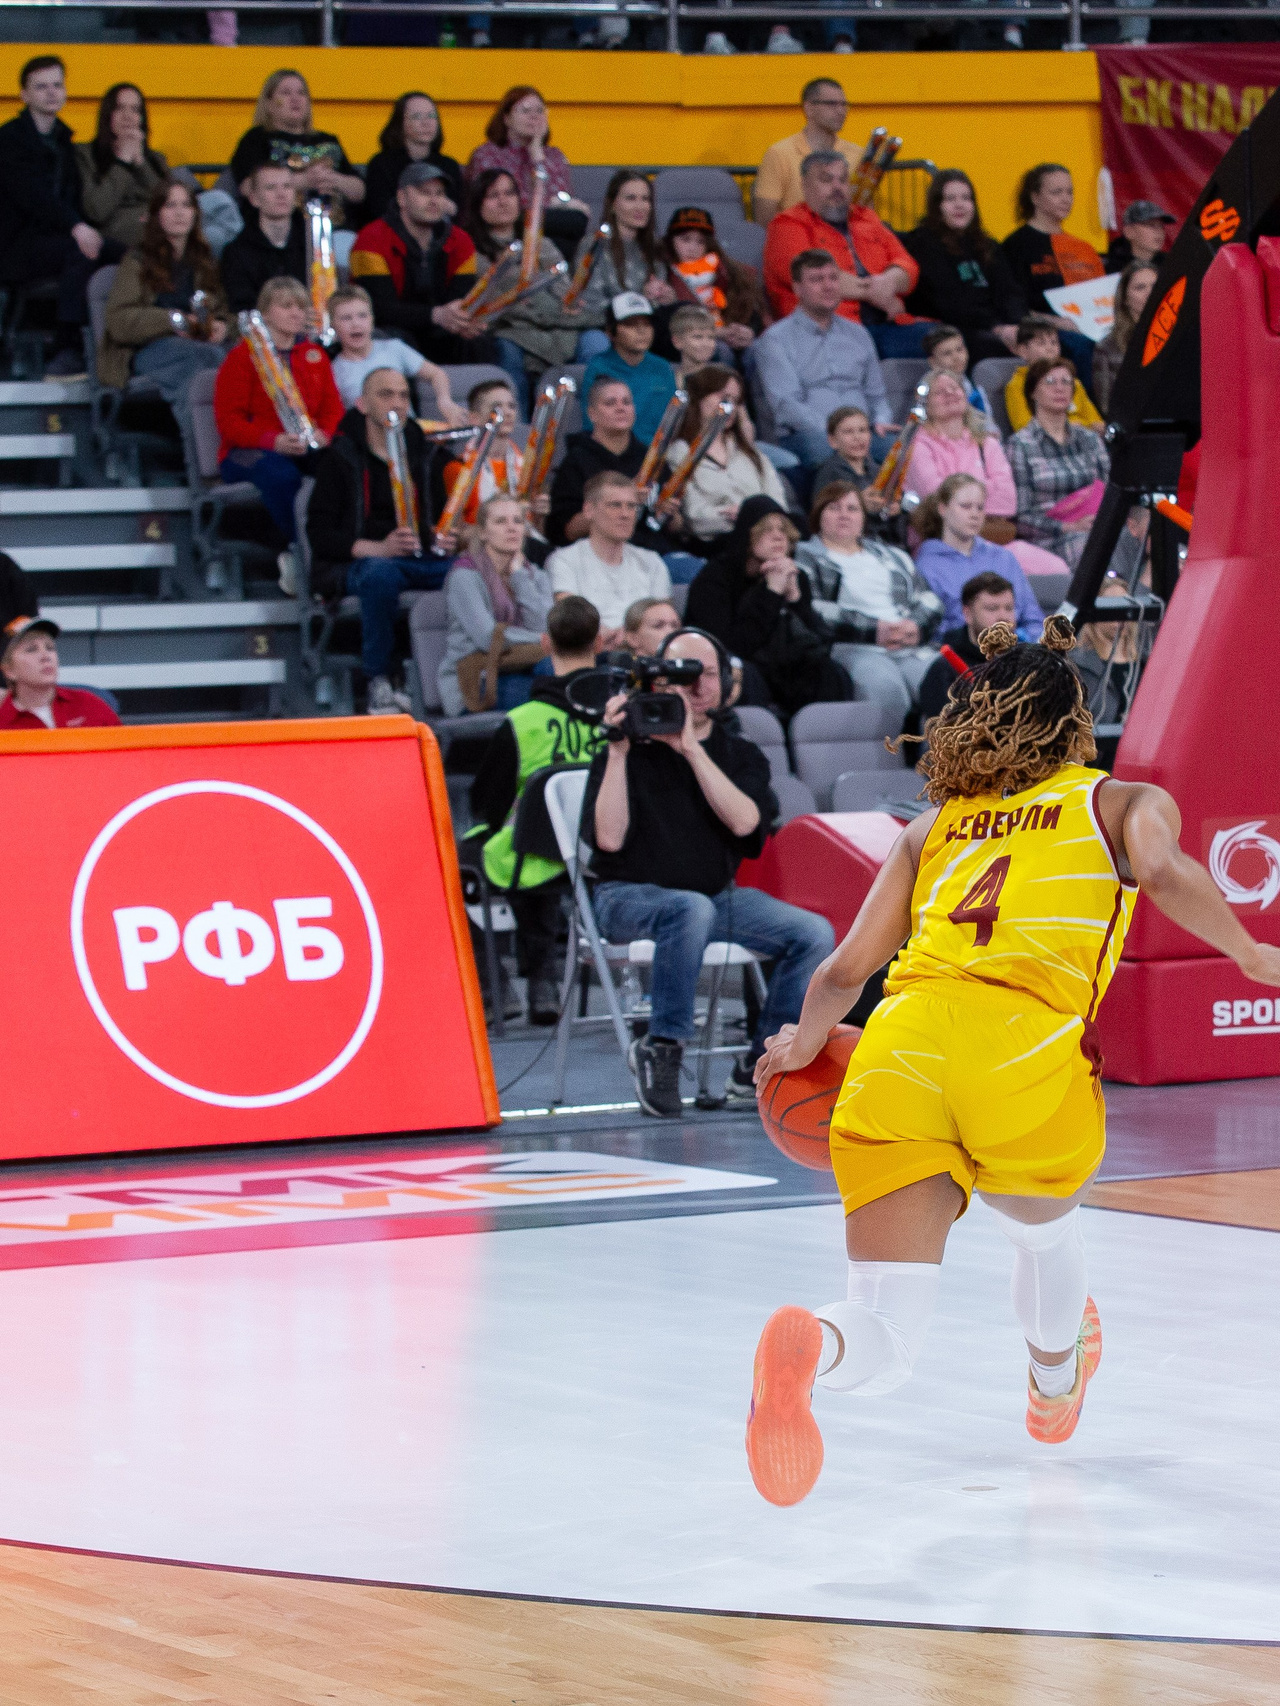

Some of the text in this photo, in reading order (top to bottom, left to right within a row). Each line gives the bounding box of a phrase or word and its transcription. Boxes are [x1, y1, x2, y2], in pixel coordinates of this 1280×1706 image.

[1118, 75, 1277, 133] БК НАД
[112, 896, 345, 991] РФБ
[947, 854, 1012, 948] 4
